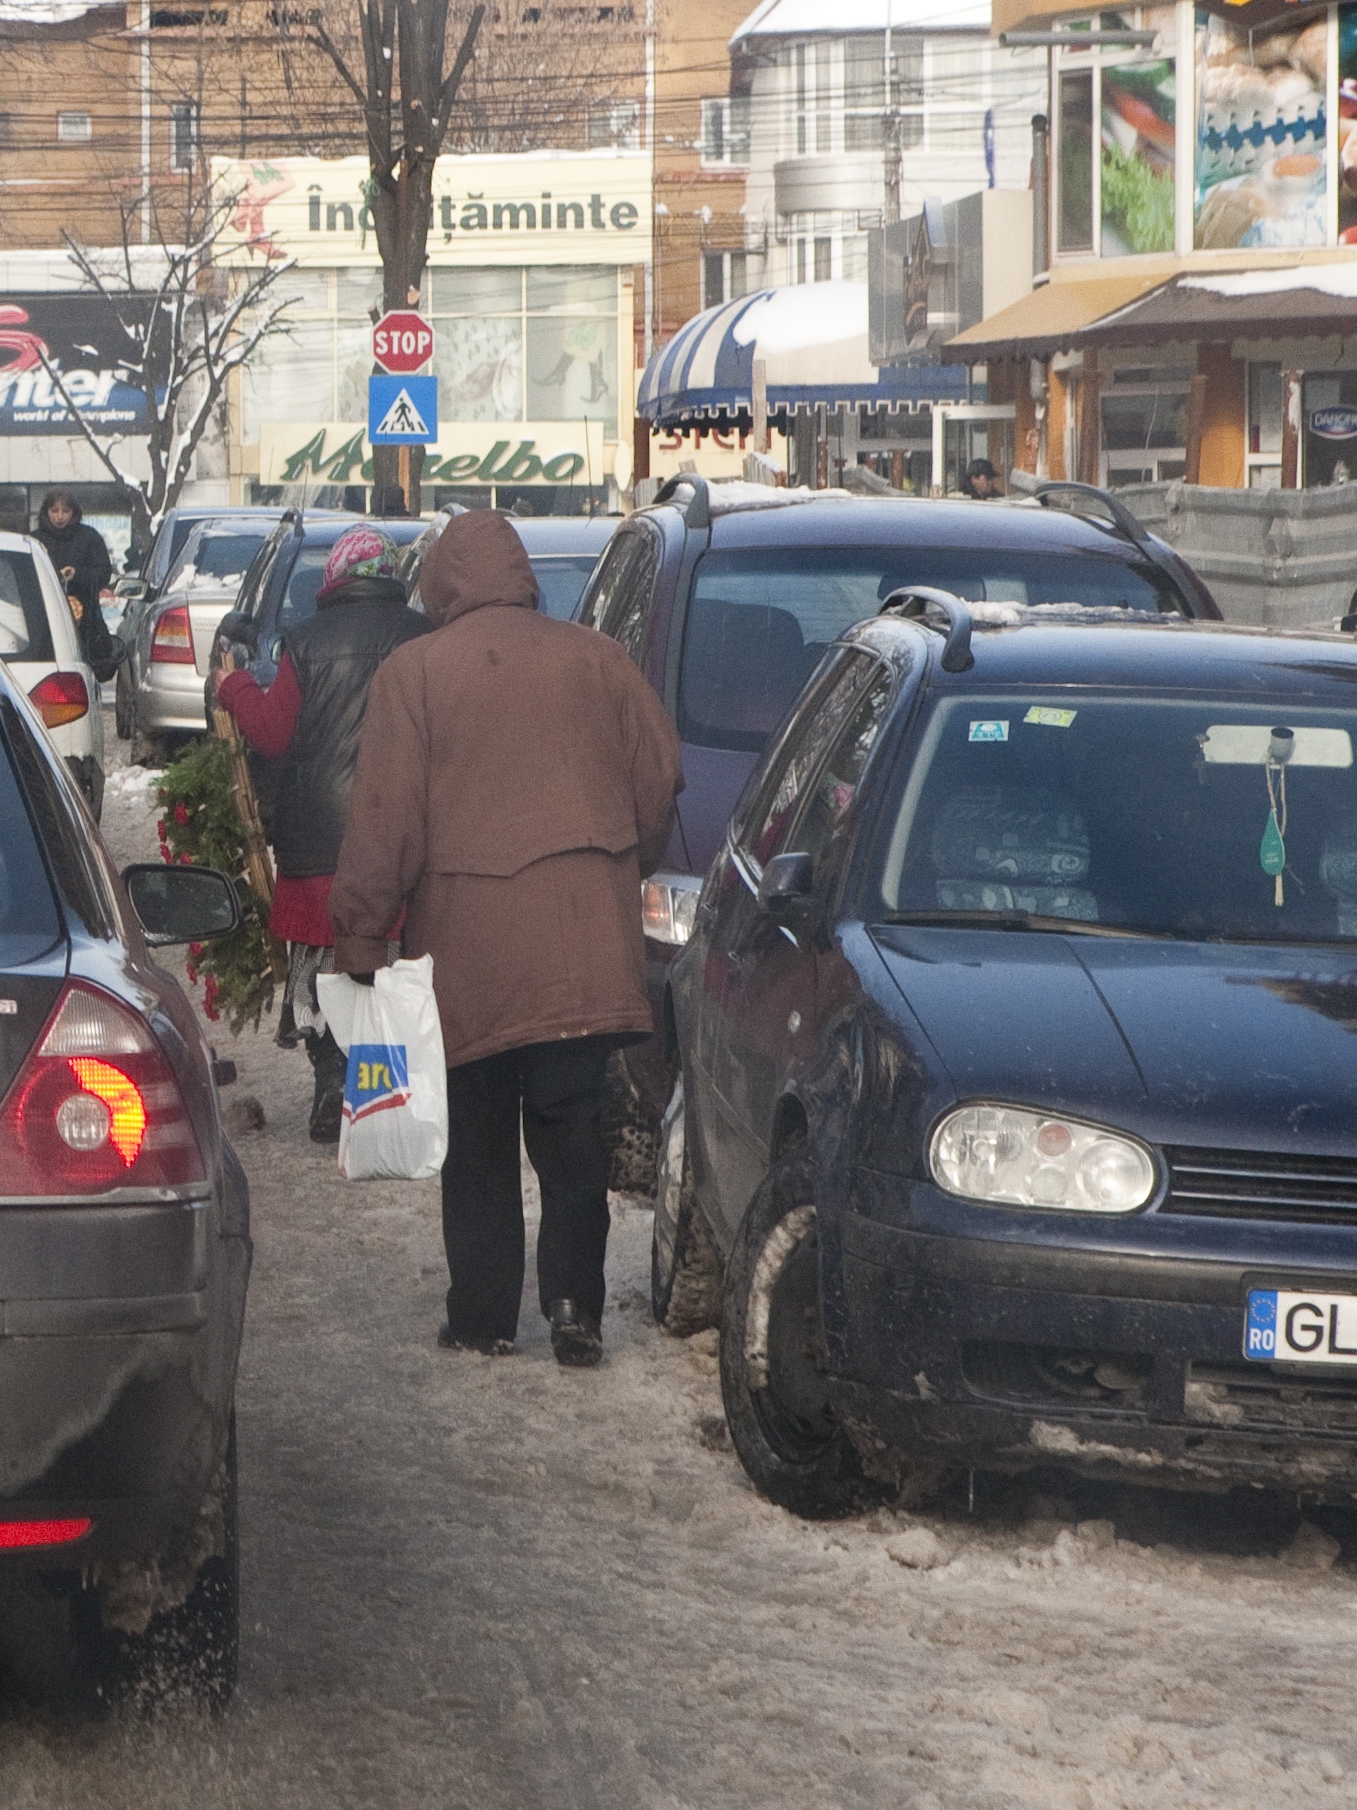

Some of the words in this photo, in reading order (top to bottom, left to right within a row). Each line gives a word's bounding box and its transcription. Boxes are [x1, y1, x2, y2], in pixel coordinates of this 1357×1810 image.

[375, 331, 431, 355] STOP
[1248, 1327, 1275, 1351] RO
[1284, 1302, 1357, 1356] GL
